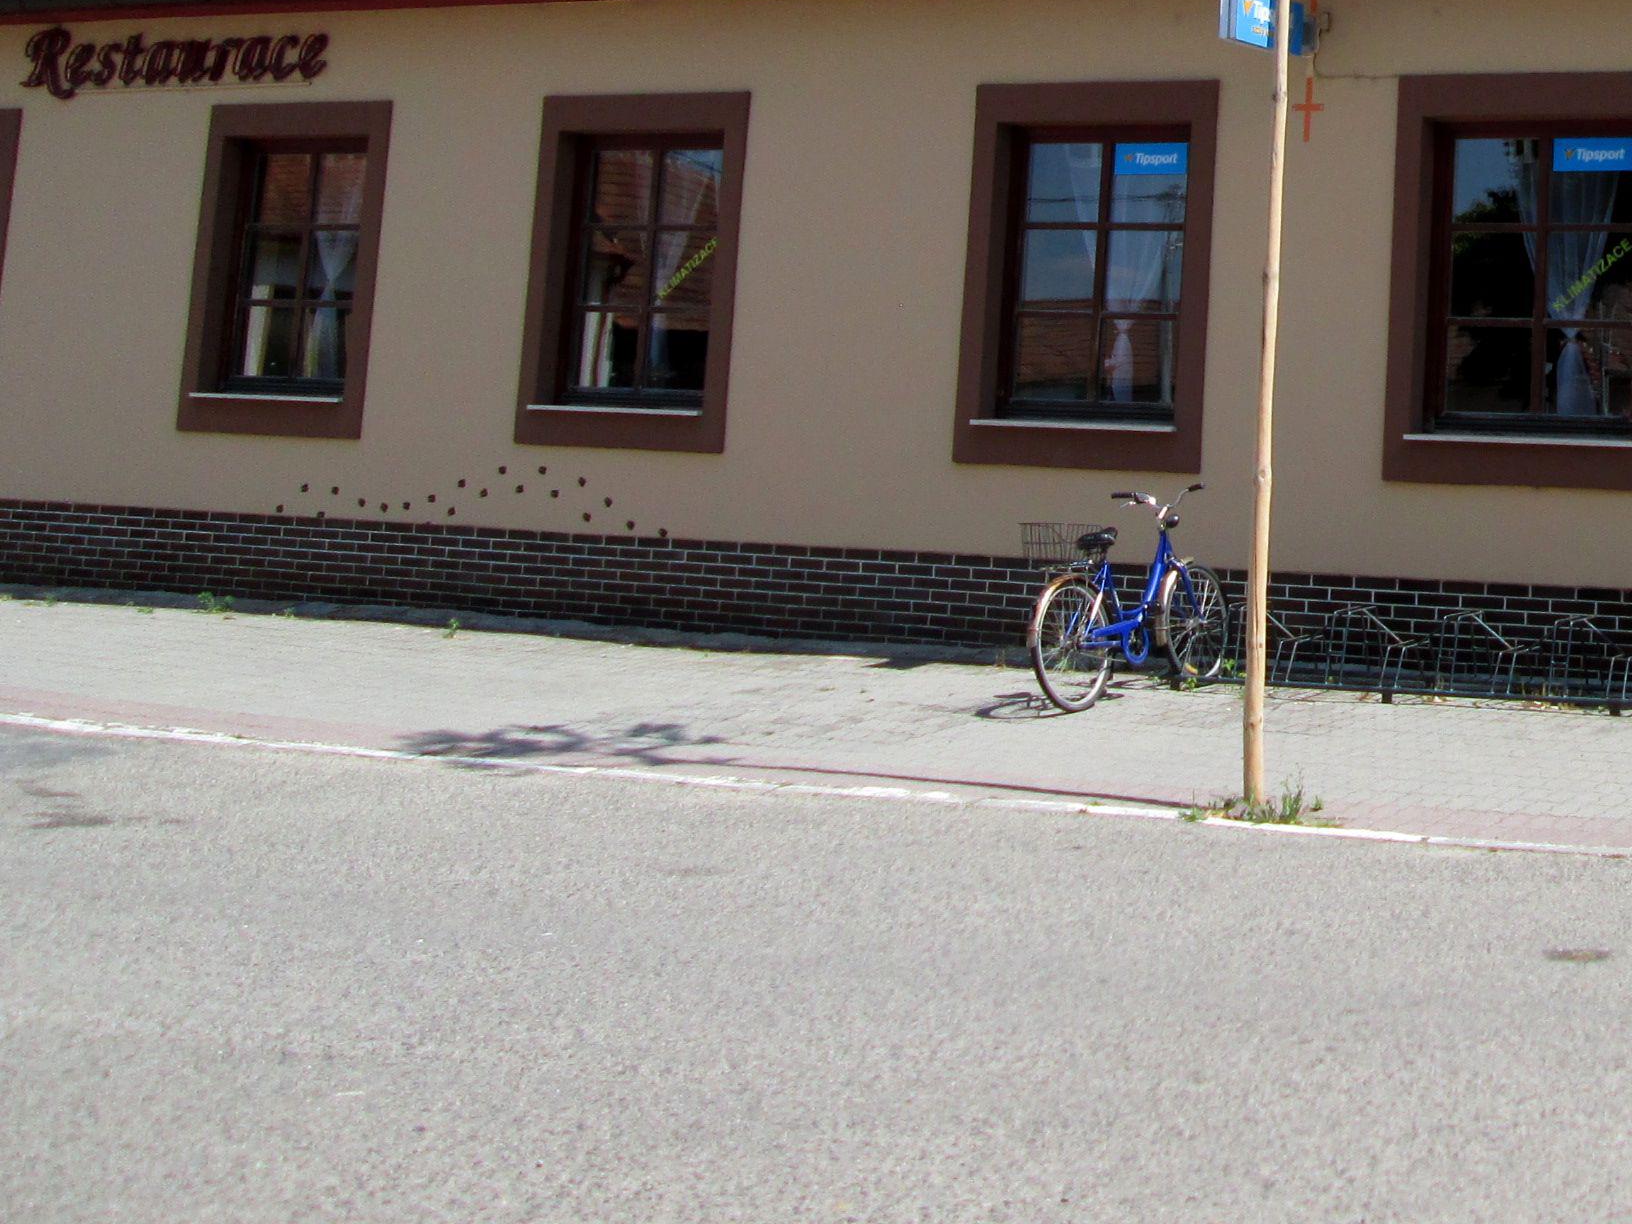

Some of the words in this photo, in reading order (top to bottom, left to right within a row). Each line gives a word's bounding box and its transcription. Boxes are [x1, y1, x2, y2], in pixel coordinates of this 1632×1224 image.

[20, 25, 331, 100] Restaurace
[1134, 152, 1178, 166] Tipsport
[1575, 147, 1626, 163] Tipsport
